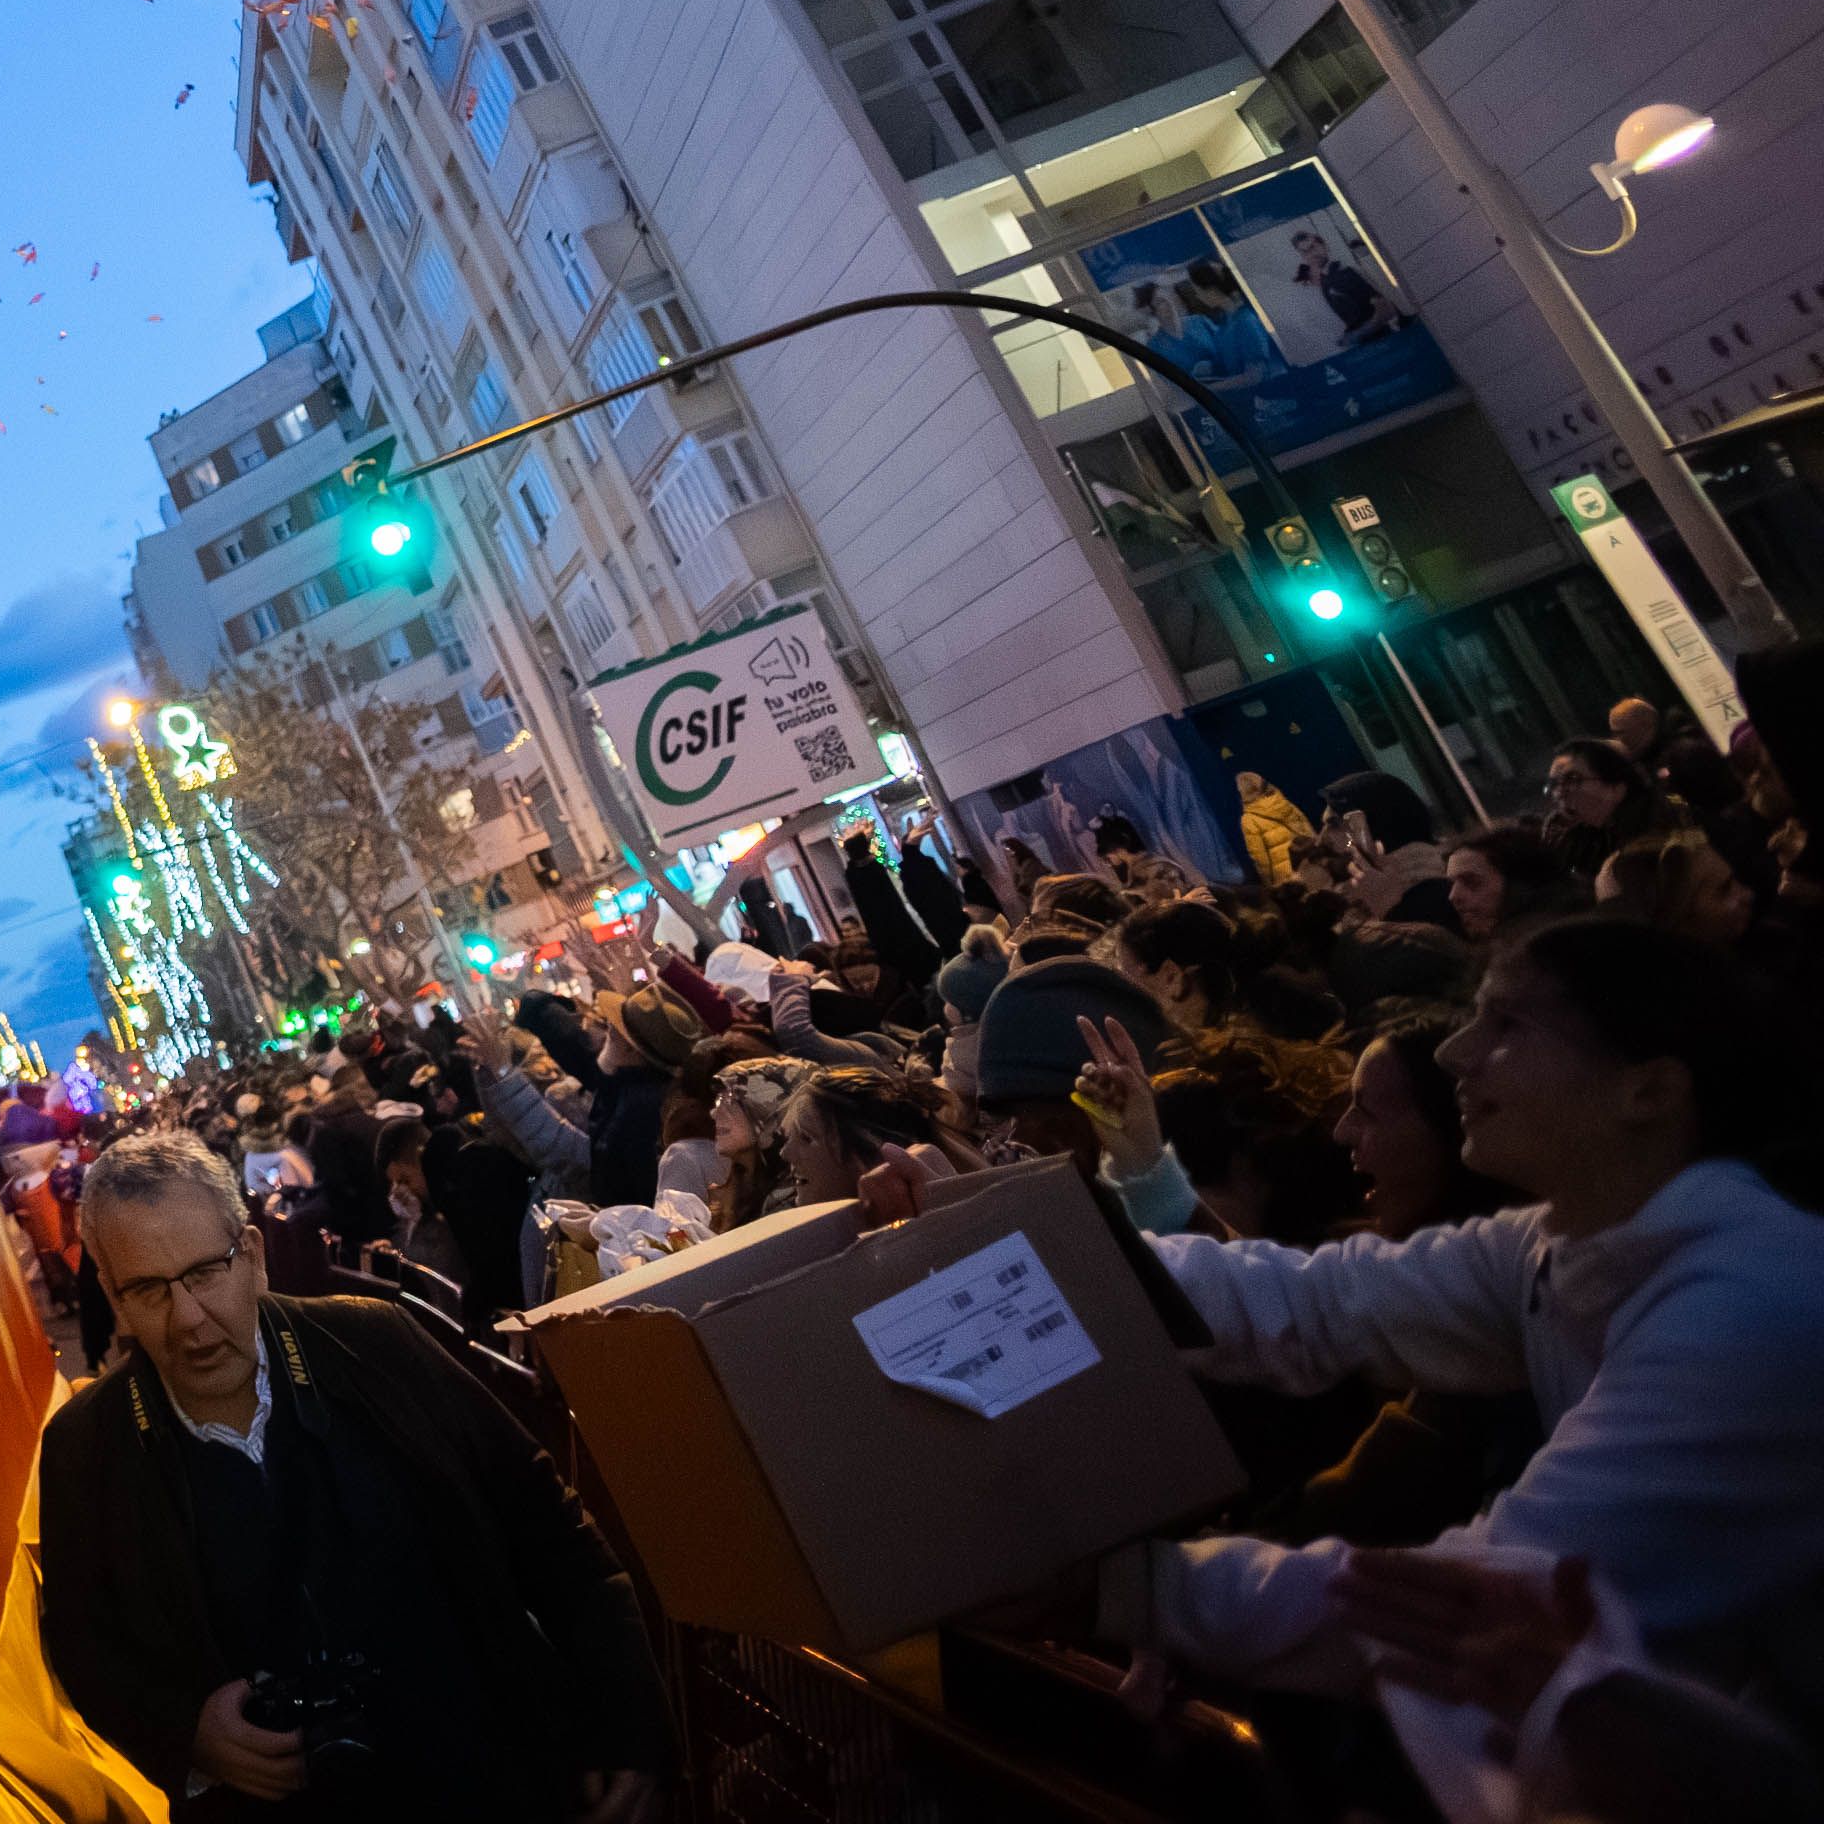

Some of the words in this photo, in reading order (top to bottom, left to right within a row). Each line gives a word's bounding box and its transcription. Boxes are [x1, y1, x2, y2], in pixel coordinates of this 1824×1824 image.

[1349, 505, 1376, 523] BUS
[786, 681, 827, 702] voto
[660, 694, 747, 764] CSIF
[776, 703, 838, 733] palabra
[279, 1331, 309, 1385] Nikon
[128, 1376, 150, 1431] Nikon
